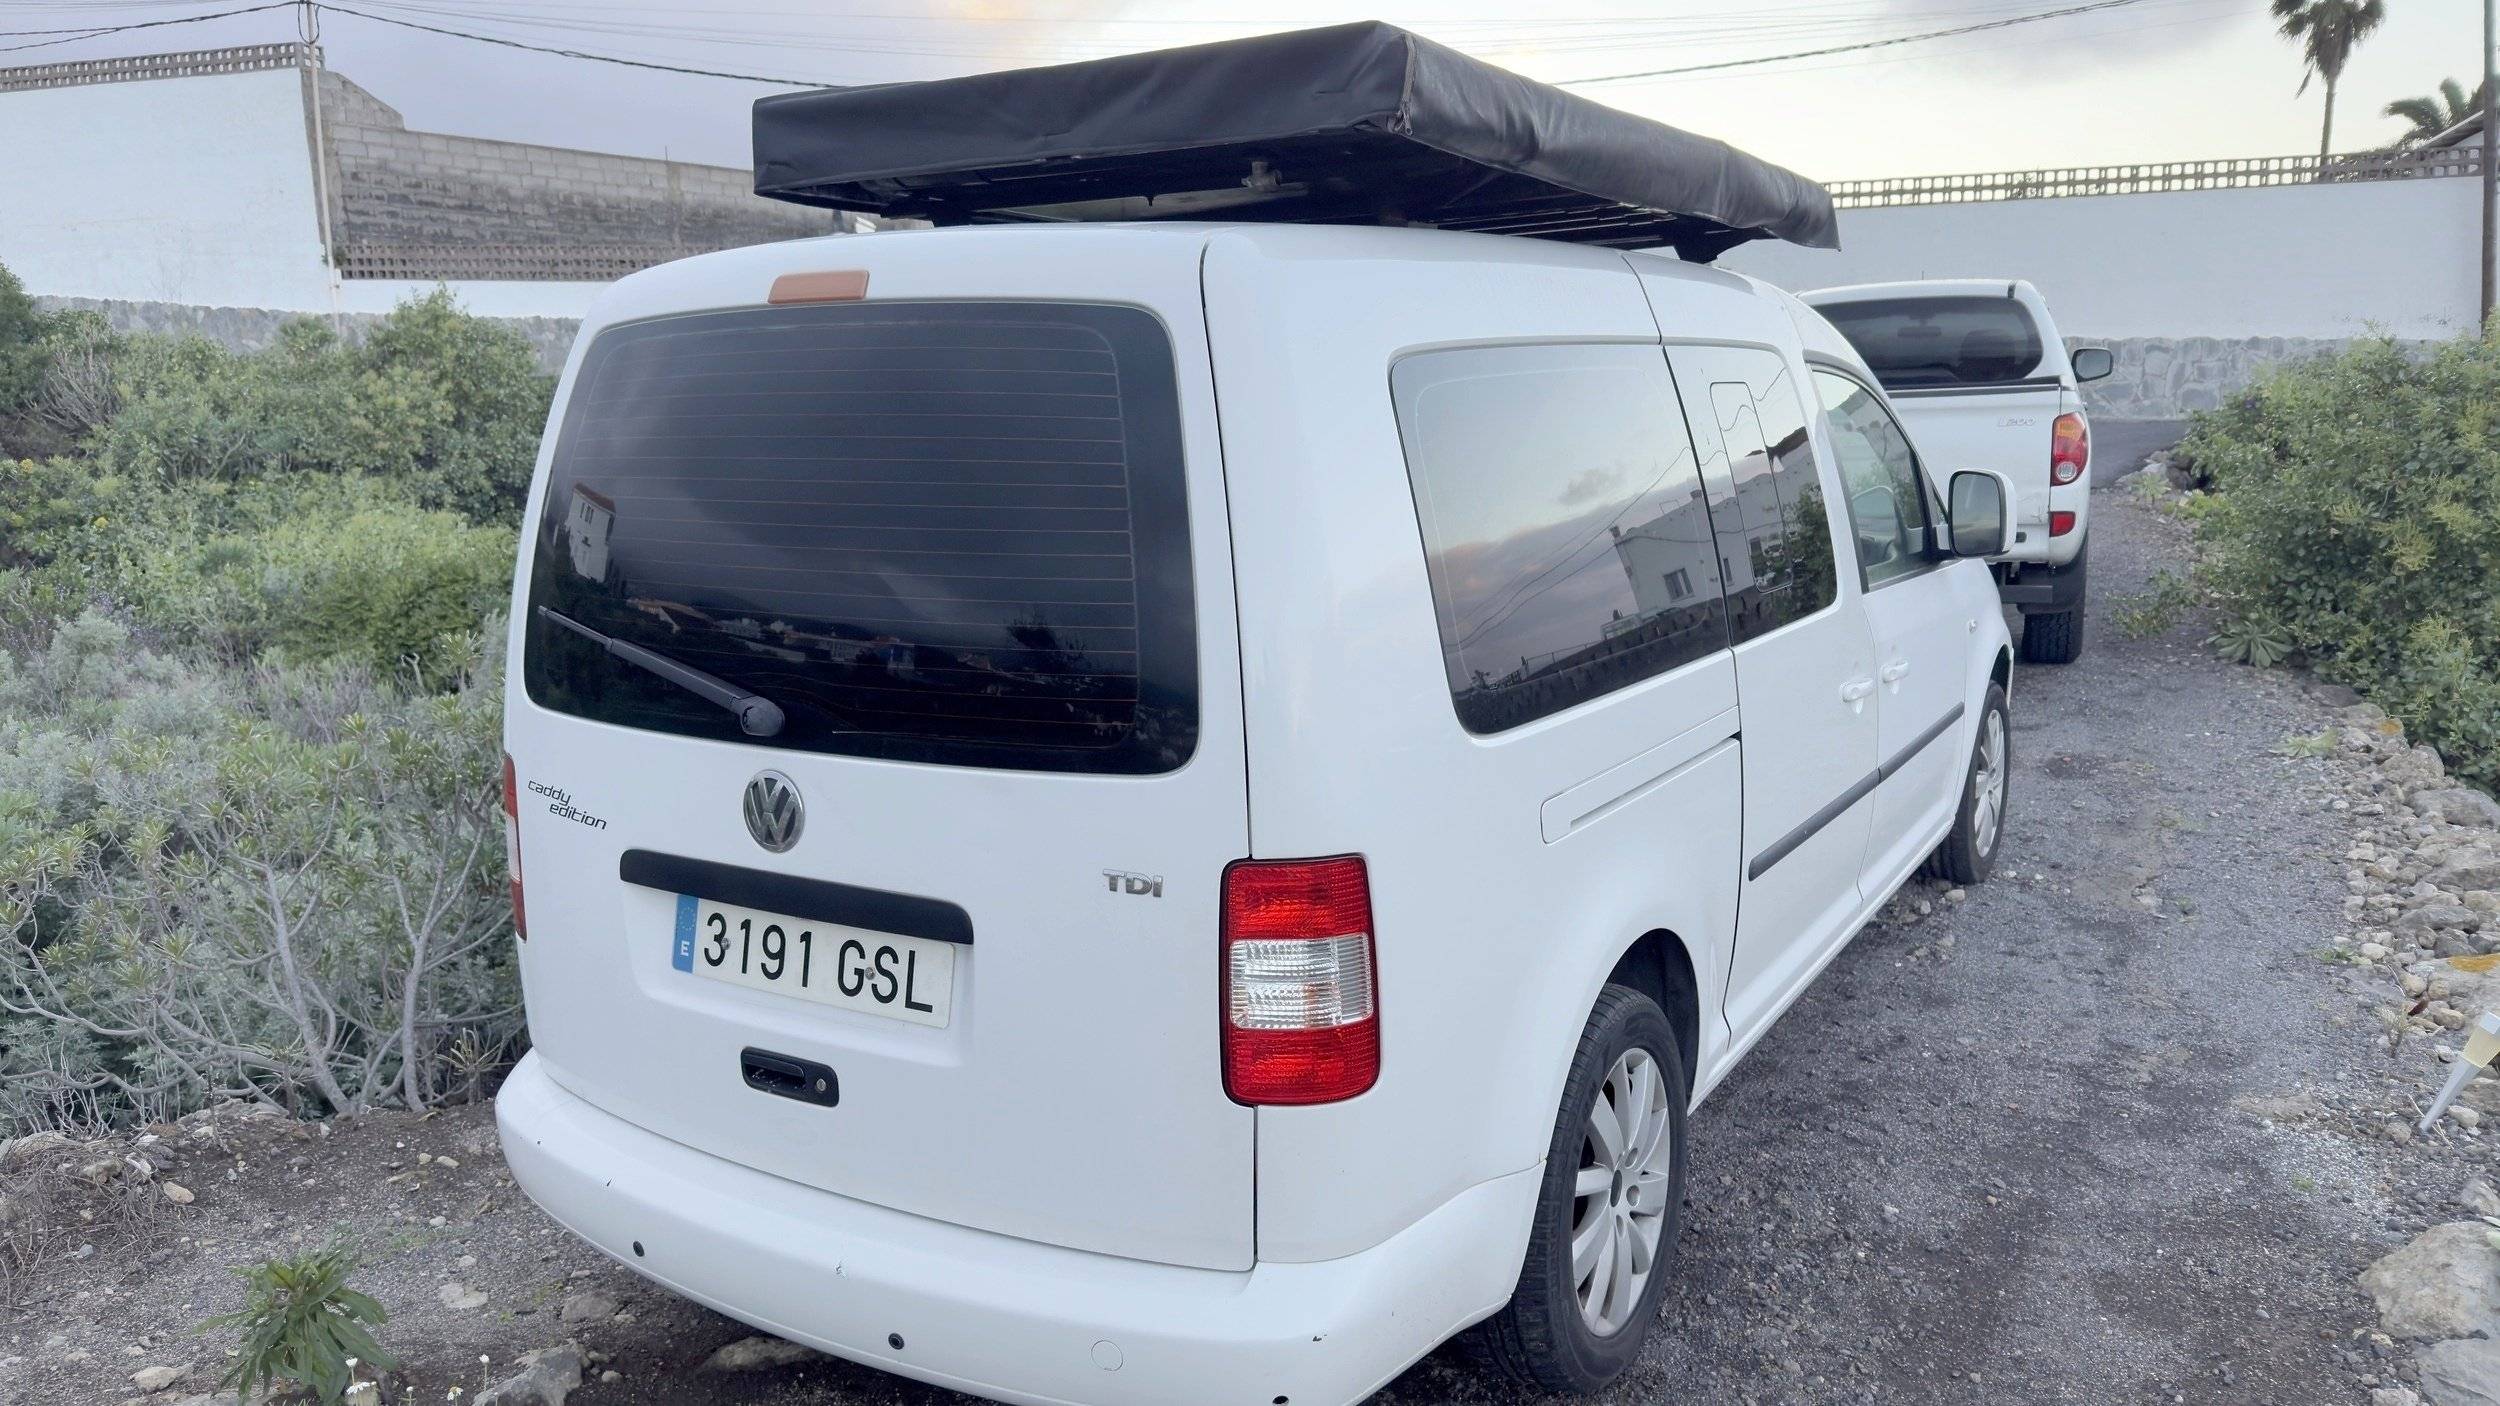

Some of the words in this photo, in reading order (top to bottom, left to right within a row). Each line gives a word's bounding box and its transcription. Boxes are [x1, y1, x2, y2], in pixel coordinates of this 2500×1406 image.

[527, 780, 571, 806] caddy
[549, 803, 607, 830] edition
[1102, 868, 1163, 898] TDI
[680, 940, 690, 957] E
[704, 912, 812, 988] 3191
[837, 939, 933, 1013] GSL
